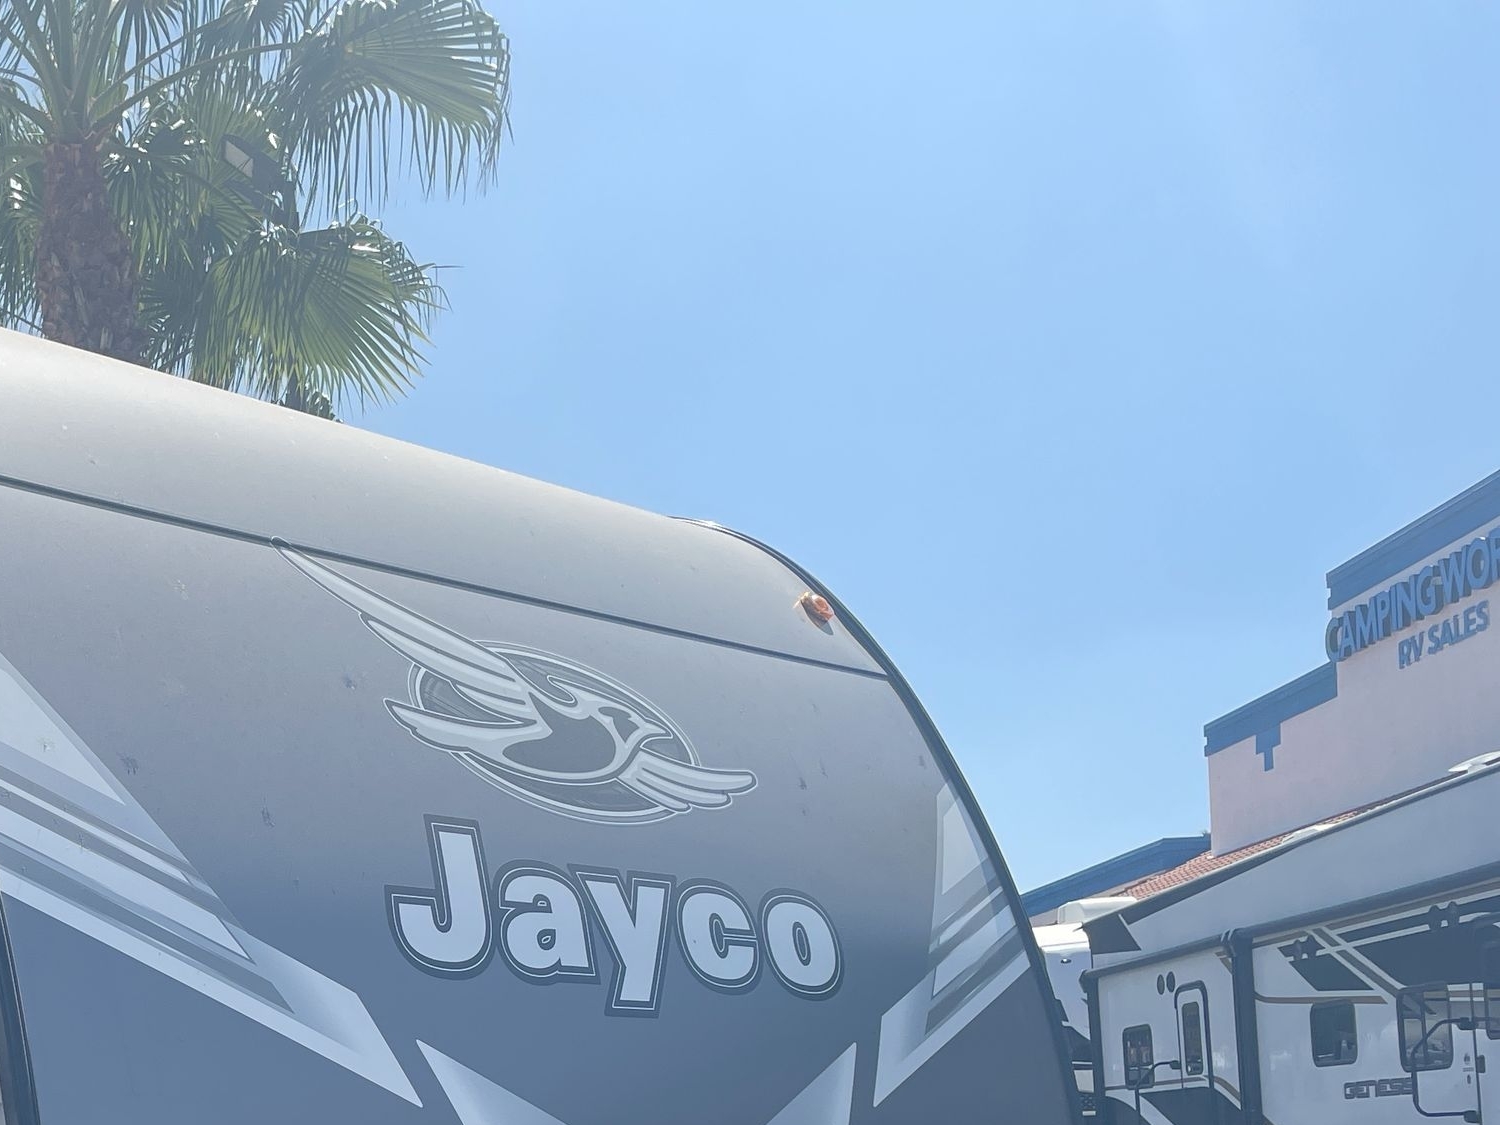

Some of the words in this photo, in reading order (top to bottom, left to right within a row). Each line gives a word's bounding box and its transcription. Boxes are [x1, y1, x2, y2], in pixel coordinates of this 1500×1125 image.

[1325, 565, 1442, 663] CAMPING
[1398, 631, 1425, 669] RV
[1428, 600, 1490, 655] SALES
[385, 814, 843, 1017] Jayco
